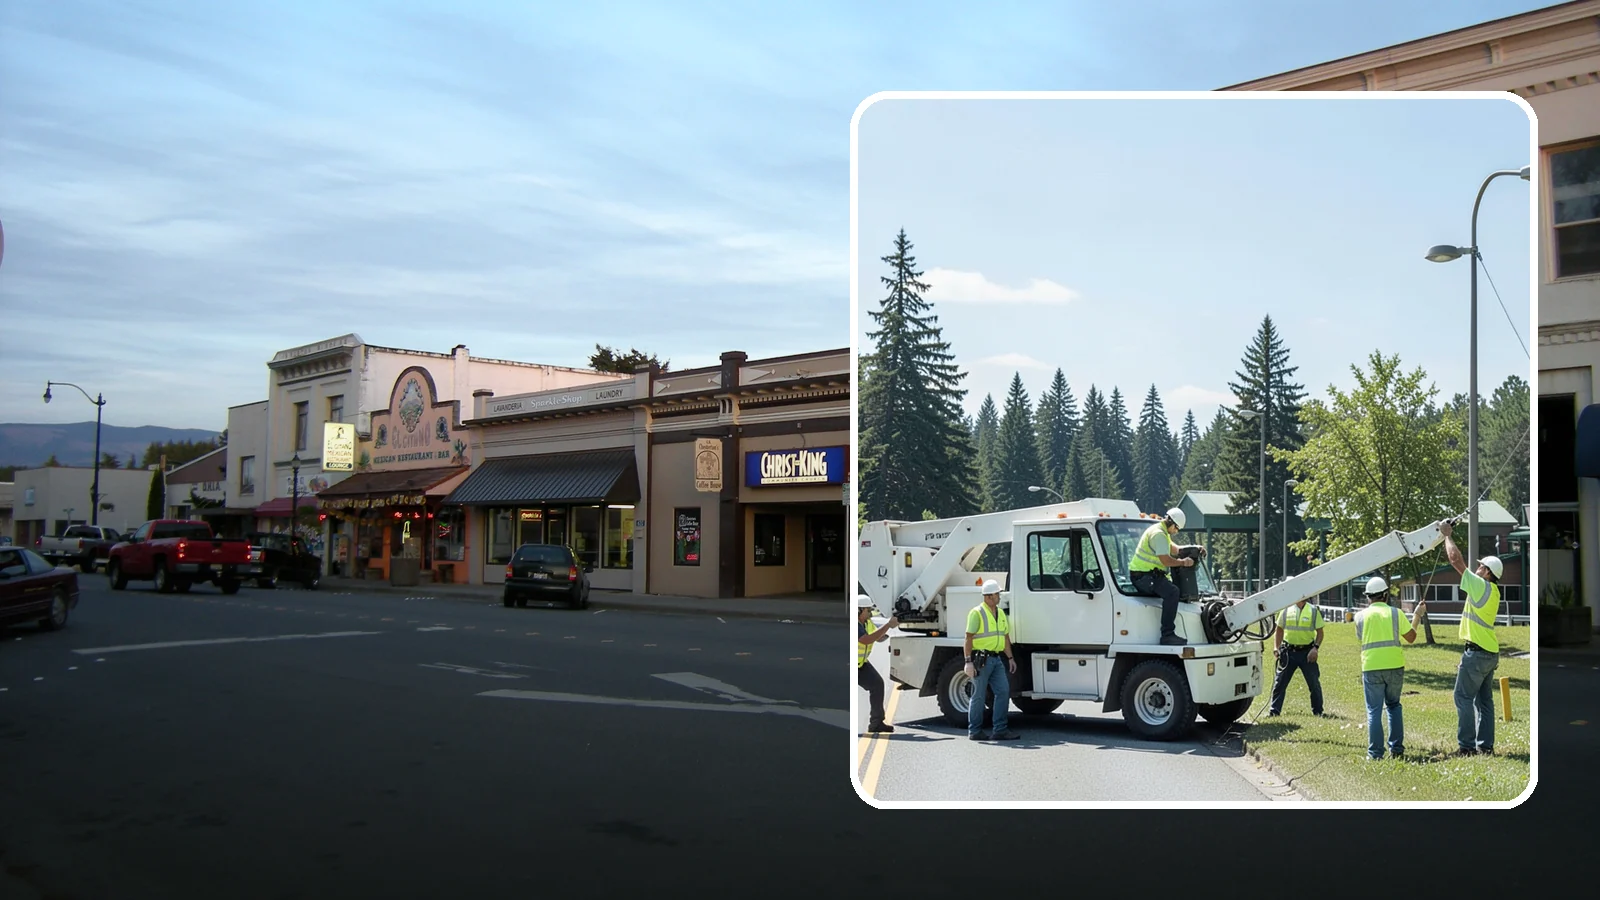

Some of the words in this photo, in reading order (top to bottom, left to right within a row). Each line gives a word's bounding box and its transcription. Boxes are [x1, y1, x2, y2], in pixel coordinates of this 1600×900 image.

[595, 388, 623, 400] LAUNDRY
[493, 402, 522, 412] LAVANDERIA
[373, 454, 396, 464] MEXICAN
[397, 451, 433, 462] RESTAURANT
[438, 450, 450, 458] BAR
[761, 452, 797, 478] CHRIST
[799, 449, 827, 476] KING
